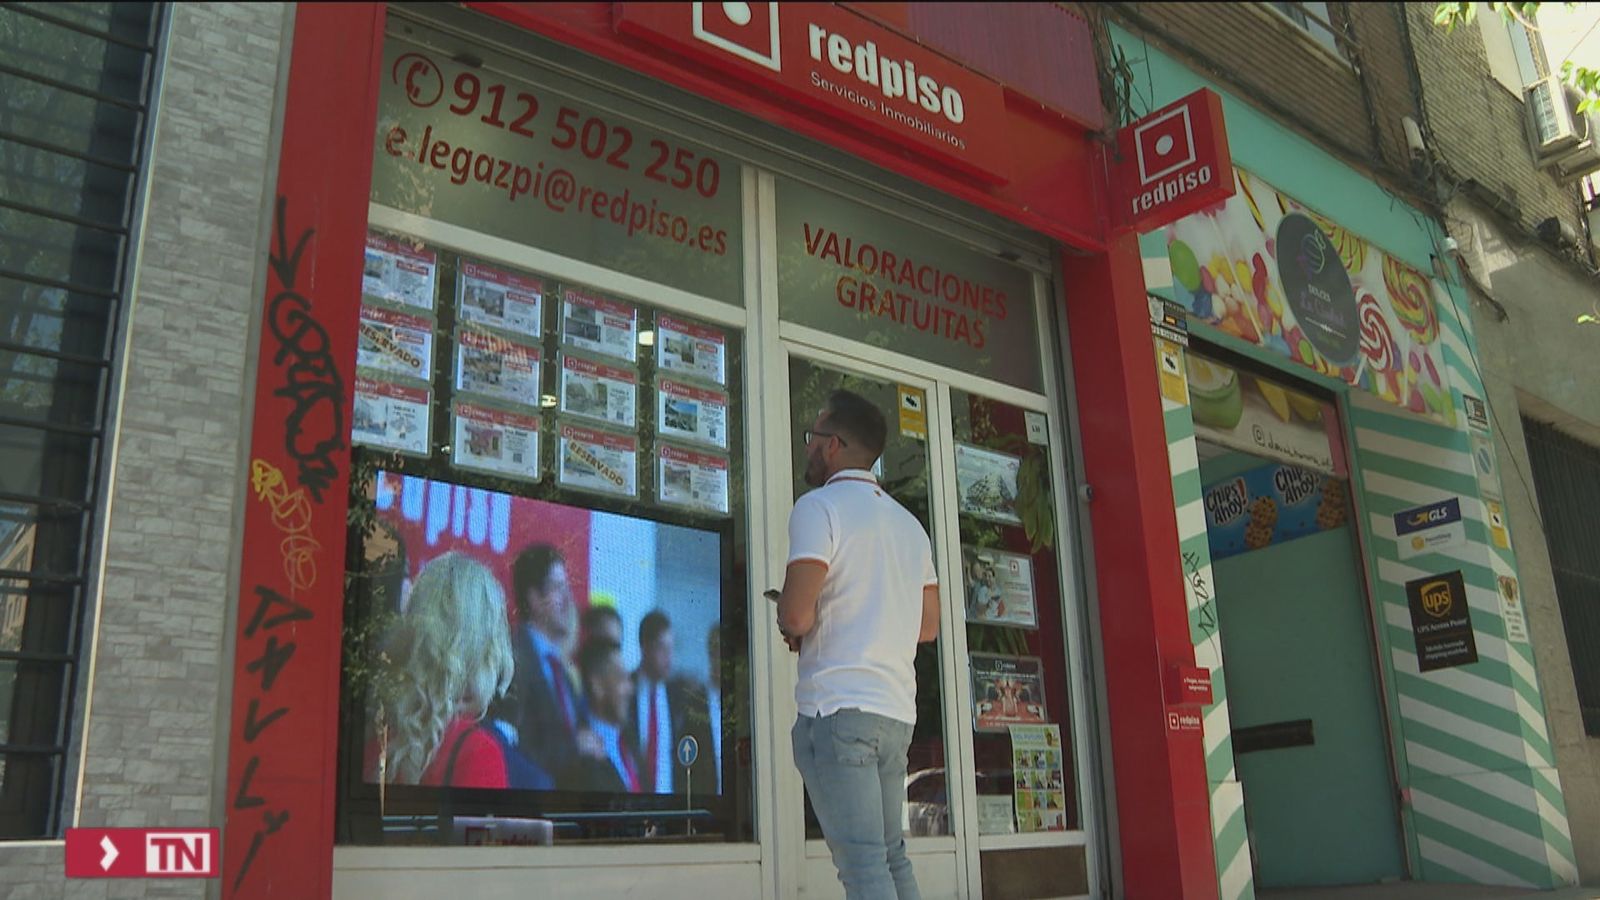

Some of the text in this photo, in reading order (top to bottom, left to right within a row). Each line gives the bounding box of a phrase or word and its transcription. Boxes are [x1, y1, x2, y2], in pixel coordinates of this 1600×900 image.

[808, 22, 966, 125] redpiso
[810, 71, 967, 151] Servicios Inmobiliarios
[449, 72, 720, 199] 912 502 250
[386, 124, 728, 256] e.legazpi@redpiso.es
[1132, 163, 1212, 215] redpiso
[803, 222, 1008, 322] VALORACIONES
[836, 275, 986, 351] GRATUITAS
[570, 442, 624, 487] RESERVADO
[1428, 506, 1448, 522] GLS
[1424, 591, 1450, 613] ups
